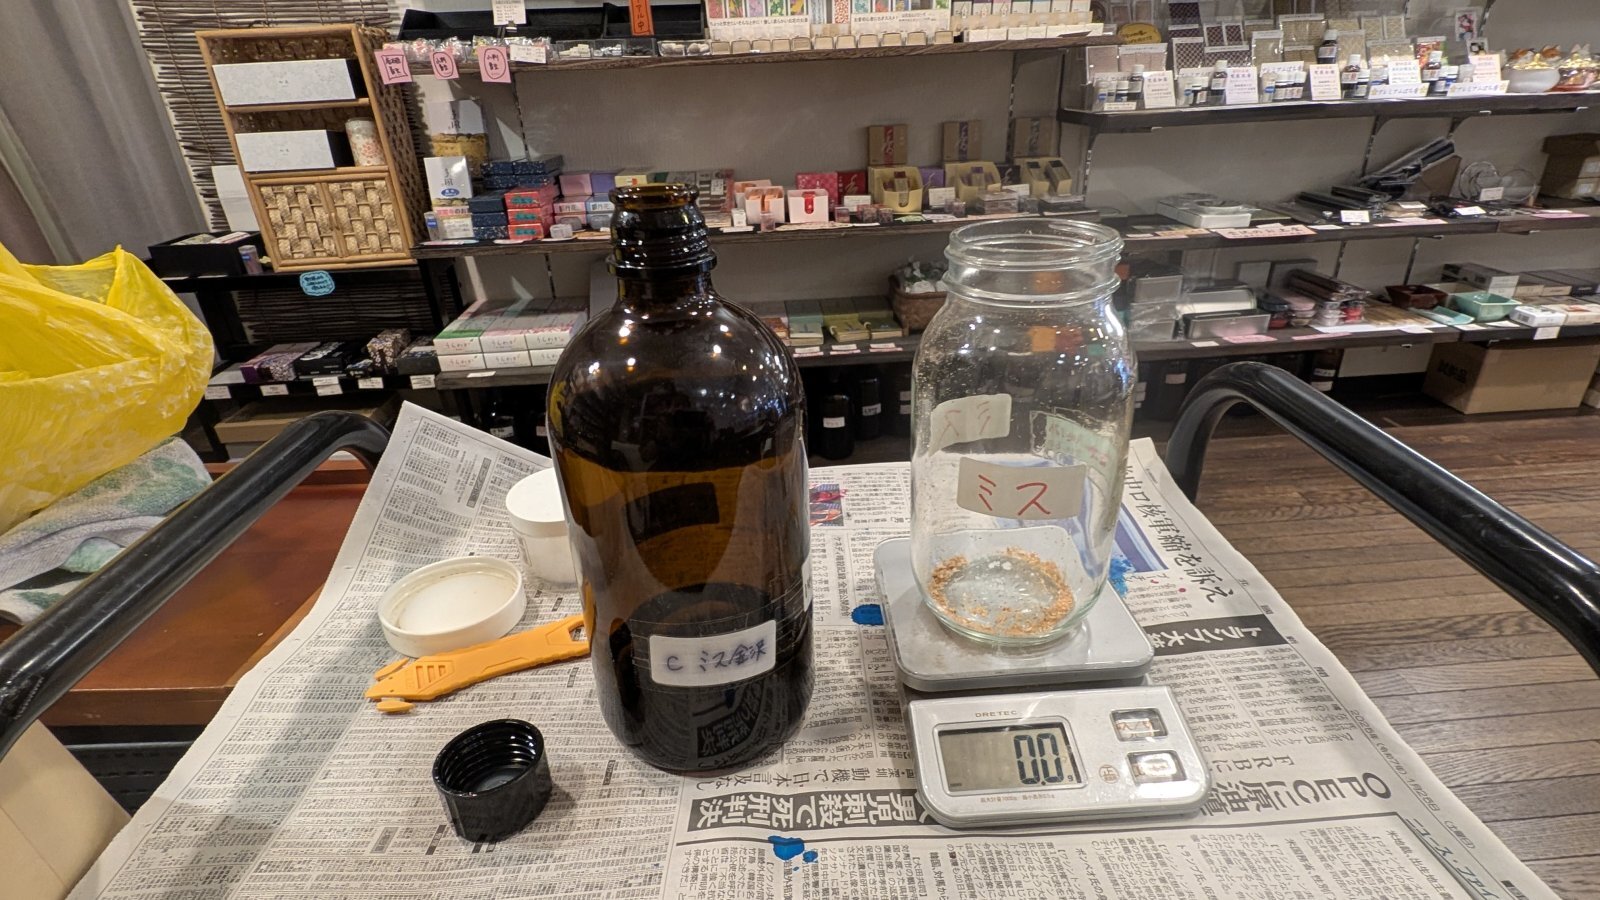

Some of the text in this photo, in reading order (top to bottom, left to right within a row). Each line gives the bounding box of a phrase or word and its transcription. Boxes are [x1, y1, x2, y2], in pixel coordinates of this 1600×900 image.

[634, 0, 647, 31] アル中
[978, 473, 1051, 517] ミス
[974, 709, 1018, 718] DRETEC
[1350, 709, 1379, 740] 2025年
[696, 767, 871, 791] 動機で日本言及なし
[1013, 732, 1065, 786] 0.0
[1206, 754, 1296, 774] FRBに
[1200, 772, 1393, 817] OPECに原油値
[718, 847, 729, 900] 省は「不当な
[727, 847, 738, 900] 括公使を呼び
[946, 844, 968, 900] の警護も20日に
[955, 844, 978, 900] トン元大統領補
[964, 843, 987, 900] は同じくイラン
[973, 843, 995, 900] ンの暗殺対象に
[982, 843, 1007, 900] 令官殺害に関与
[1001, 843, 1024, 900] アが23日、報じ
[1010, 843, 1036, 900] トサービス）に
[1026, 842, 1055, 900] 氏とブライアン
[1100, 839, 1136, 900] 子化した「中央銀
[1157, 844, 1195, 900] 【ワシントン共
[1285, 838, 1338, 900] 米国務省、性別「
